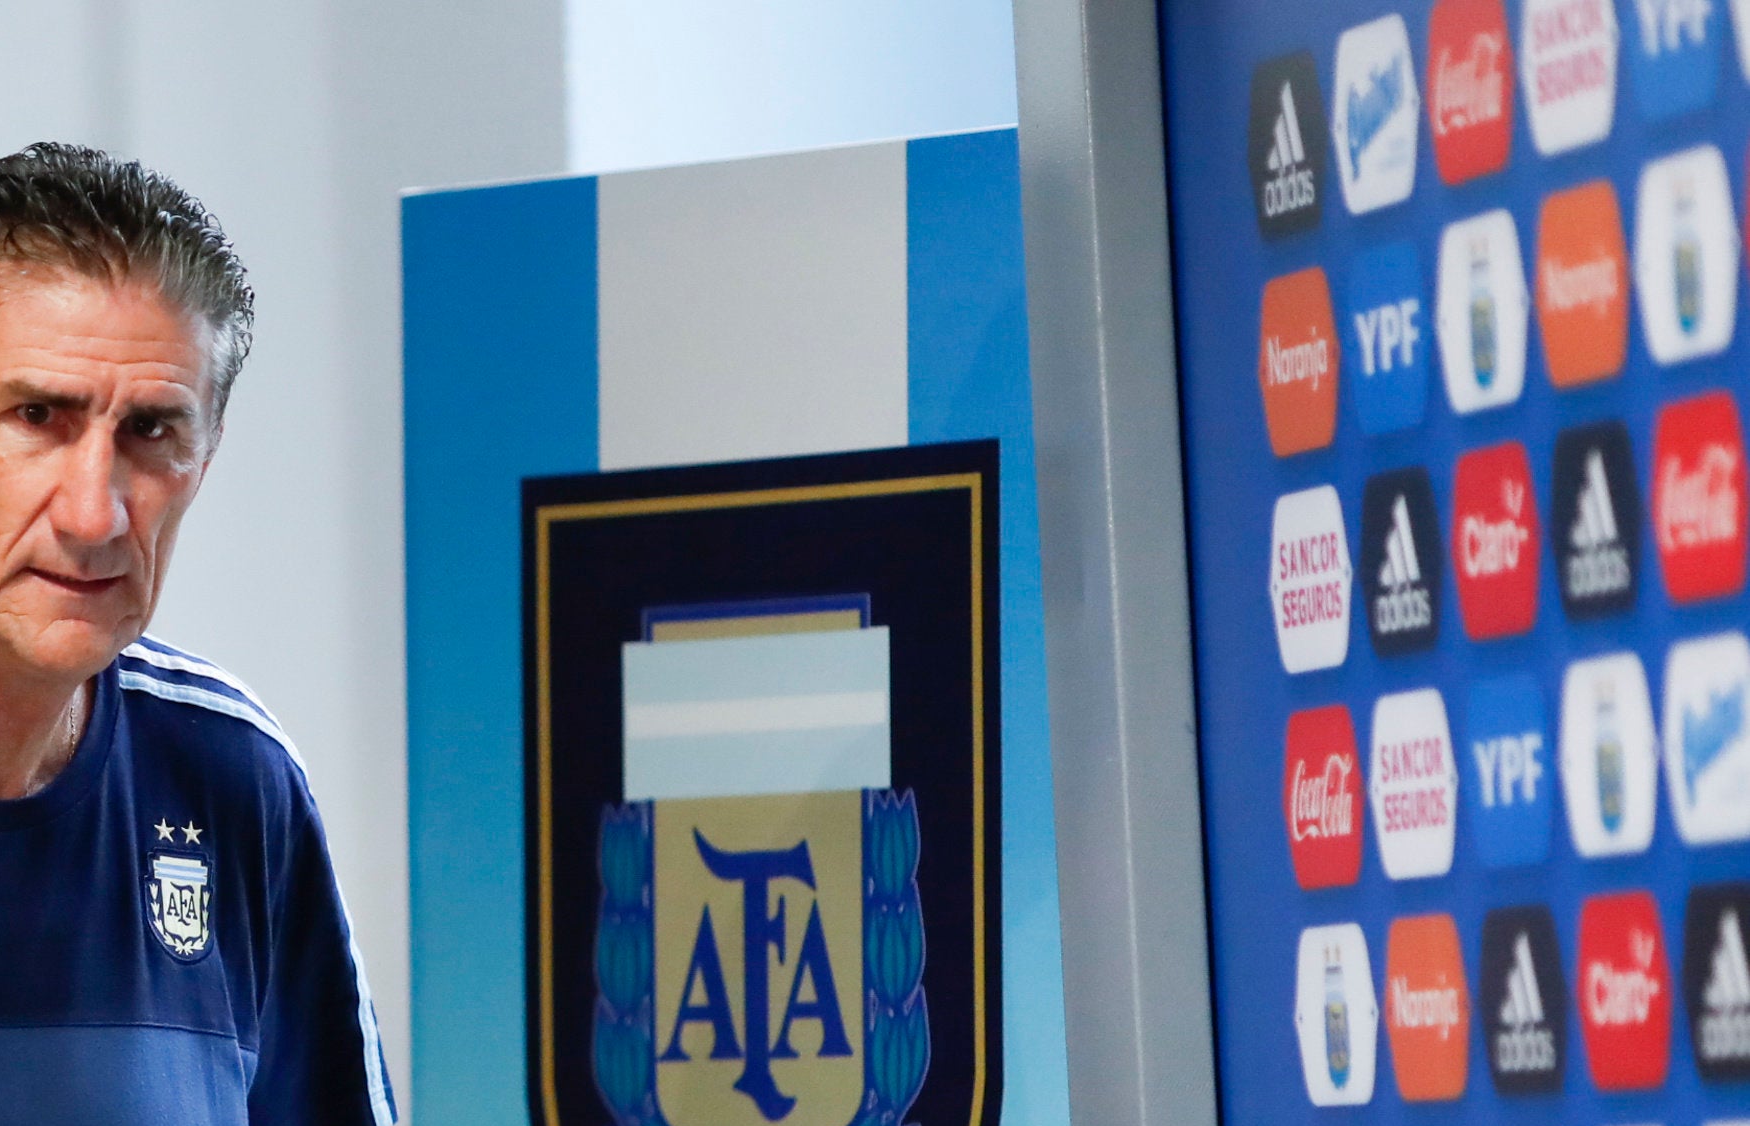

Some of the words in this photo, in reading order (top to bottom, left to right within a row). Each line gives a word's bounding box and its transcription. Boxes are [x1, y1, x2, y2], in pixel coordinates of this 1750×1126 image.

[1264, 167, 1315, 217] adidas
[1266, 328, 1328, 391] Naranja
[1355, 299, 1420, 375] YPF
[1279, 531, 1341, 580] SANCOR
[1461, 516, 1521, 578] Claro
[1282, 582, 1343, 629] SEGUROS
[1376, 588, 1432, 634] adidas
[1380, 737, 1445, 782] SANCOR
[1473, 732, 1544, 808] YPF
[1290, 753, 1354, 842] Coca-Cola
[1384, 786, 1448, 833] SEGUROS
[167, 881, 198, 926] AFA
[657, 827, 854, 1124] AFA
[1588, 962, 1649, 1025] Claro
[1391, 974, 1458, 1040] Naranja
[1498, 1027, 1555, 1073] adidas
